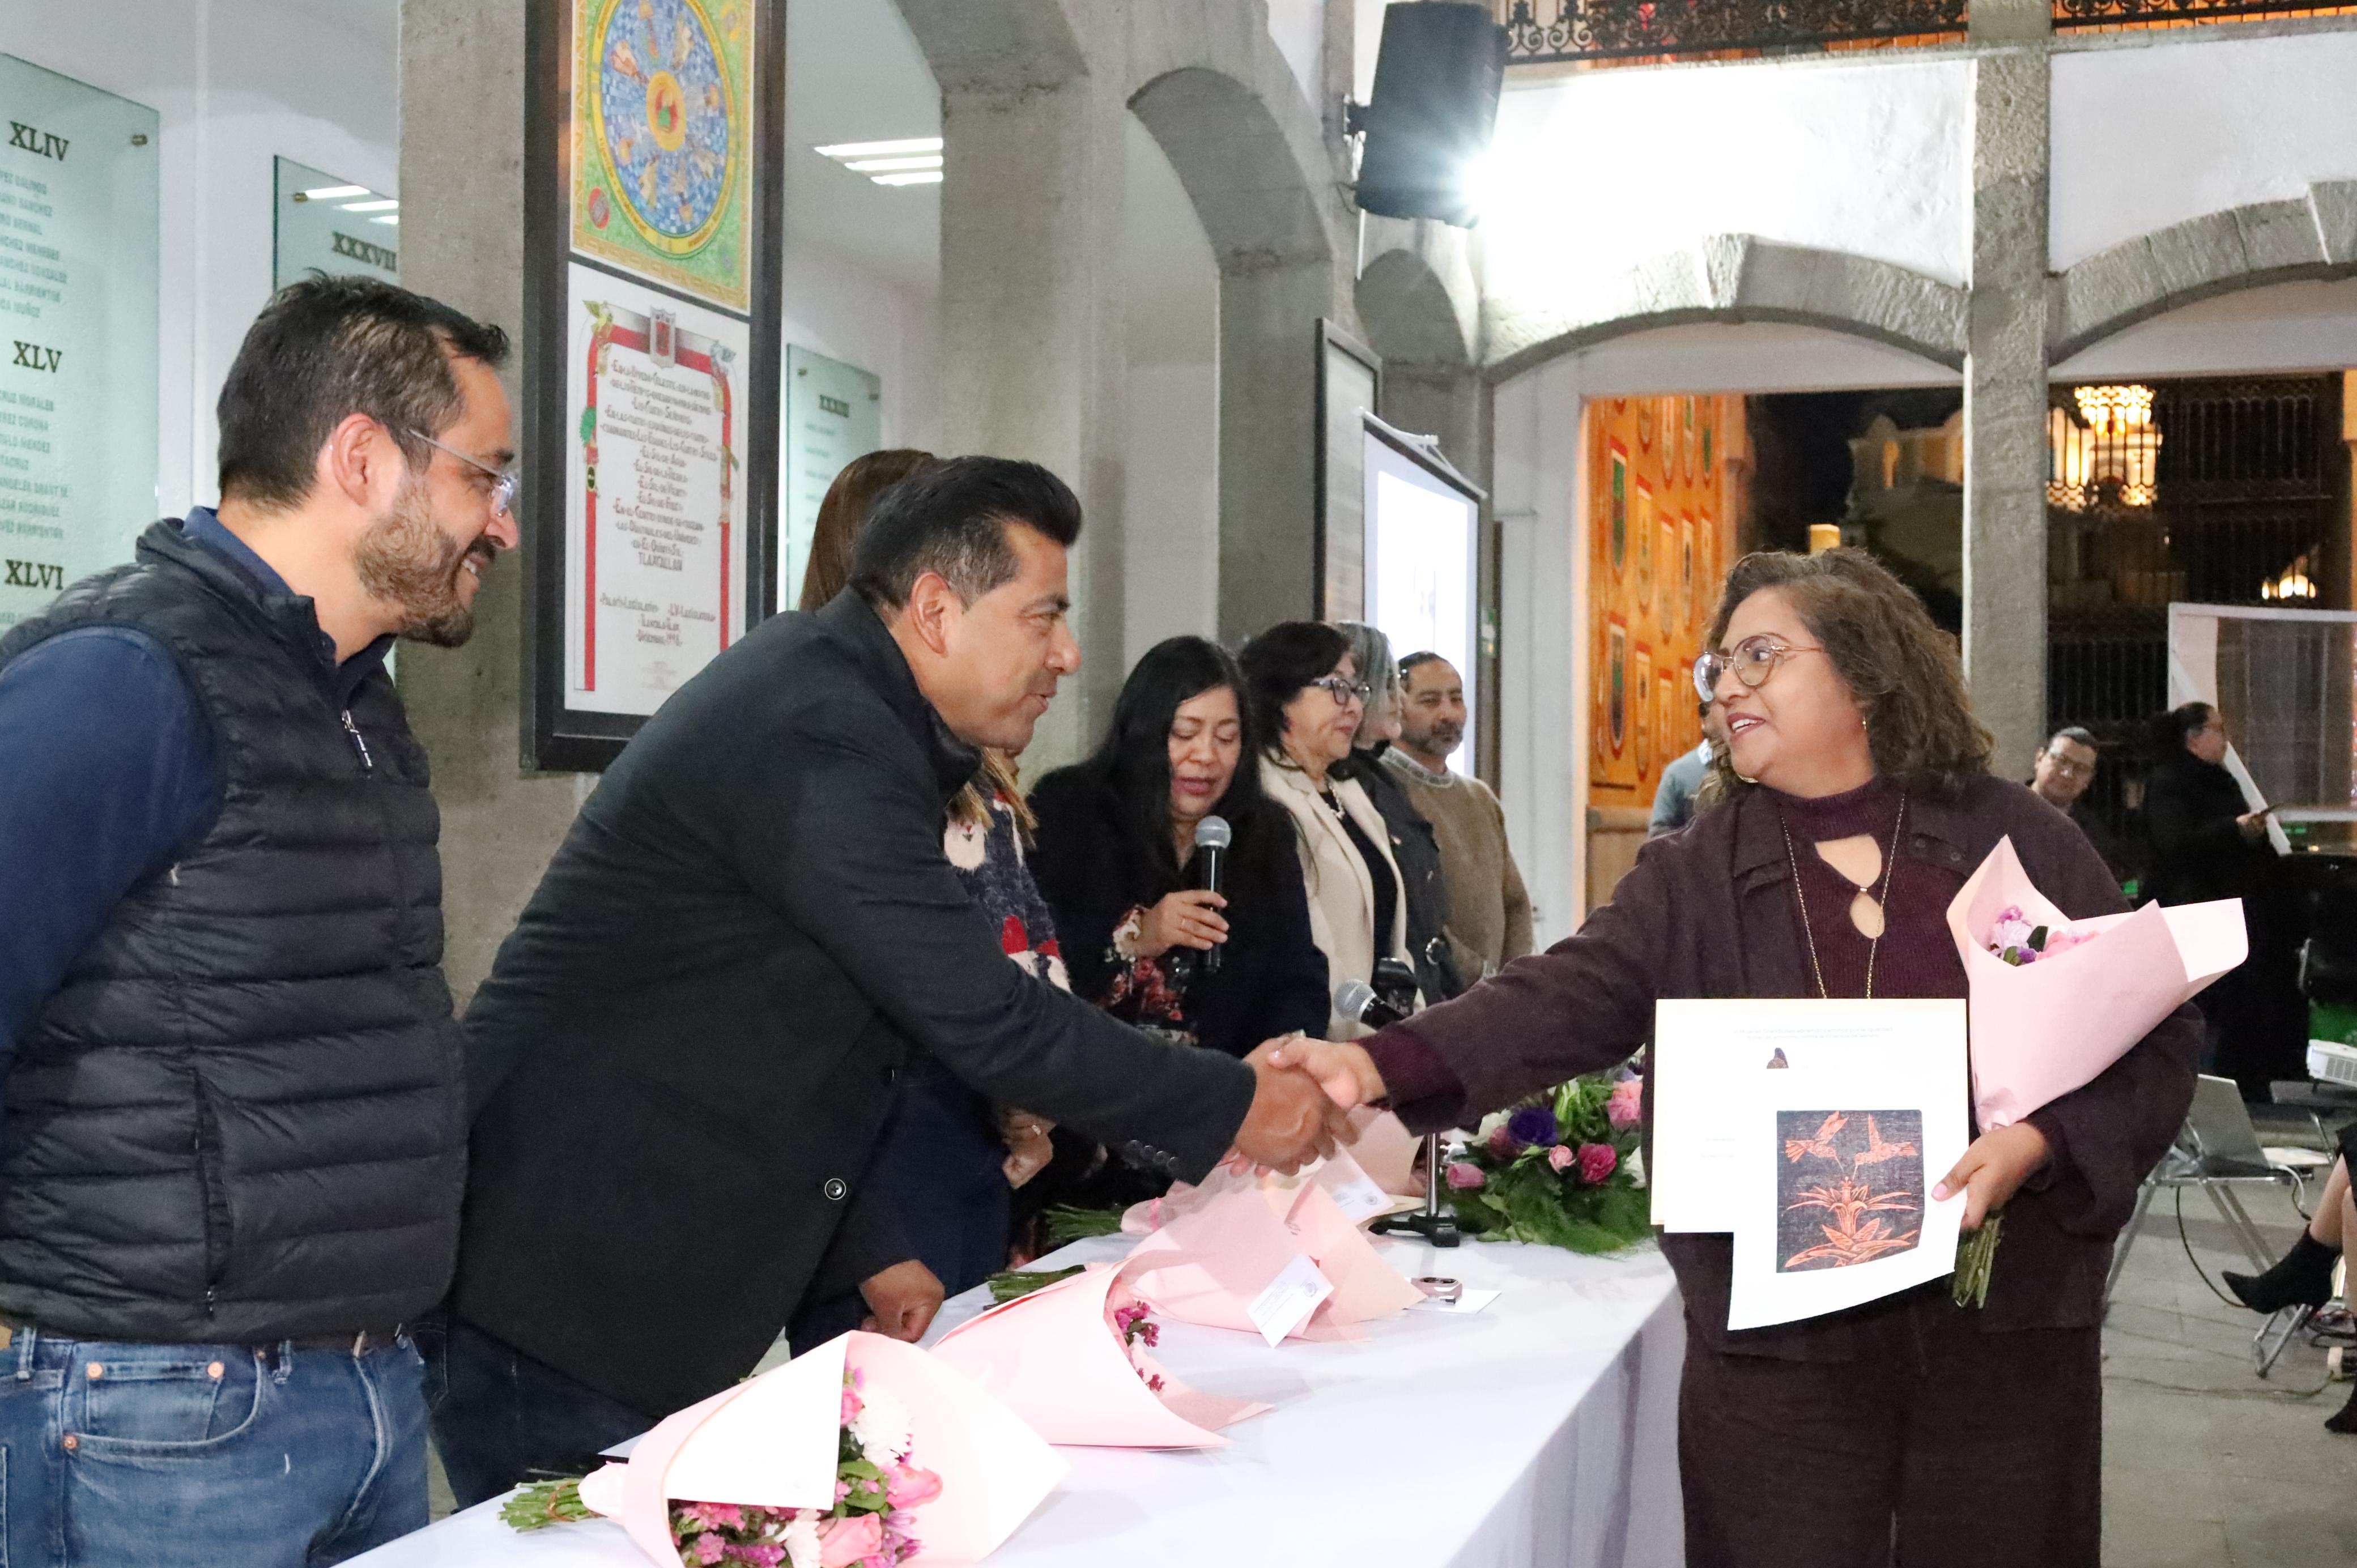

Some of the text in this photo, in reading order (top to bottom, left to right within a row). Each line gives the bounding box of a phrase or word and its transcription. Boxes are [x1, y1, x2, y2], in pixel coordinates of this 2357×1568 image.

[9, 121, 69, 161] XLIV
[14, 340, 62, 373] XLV
[5, 559, 64, 591] XLVI
